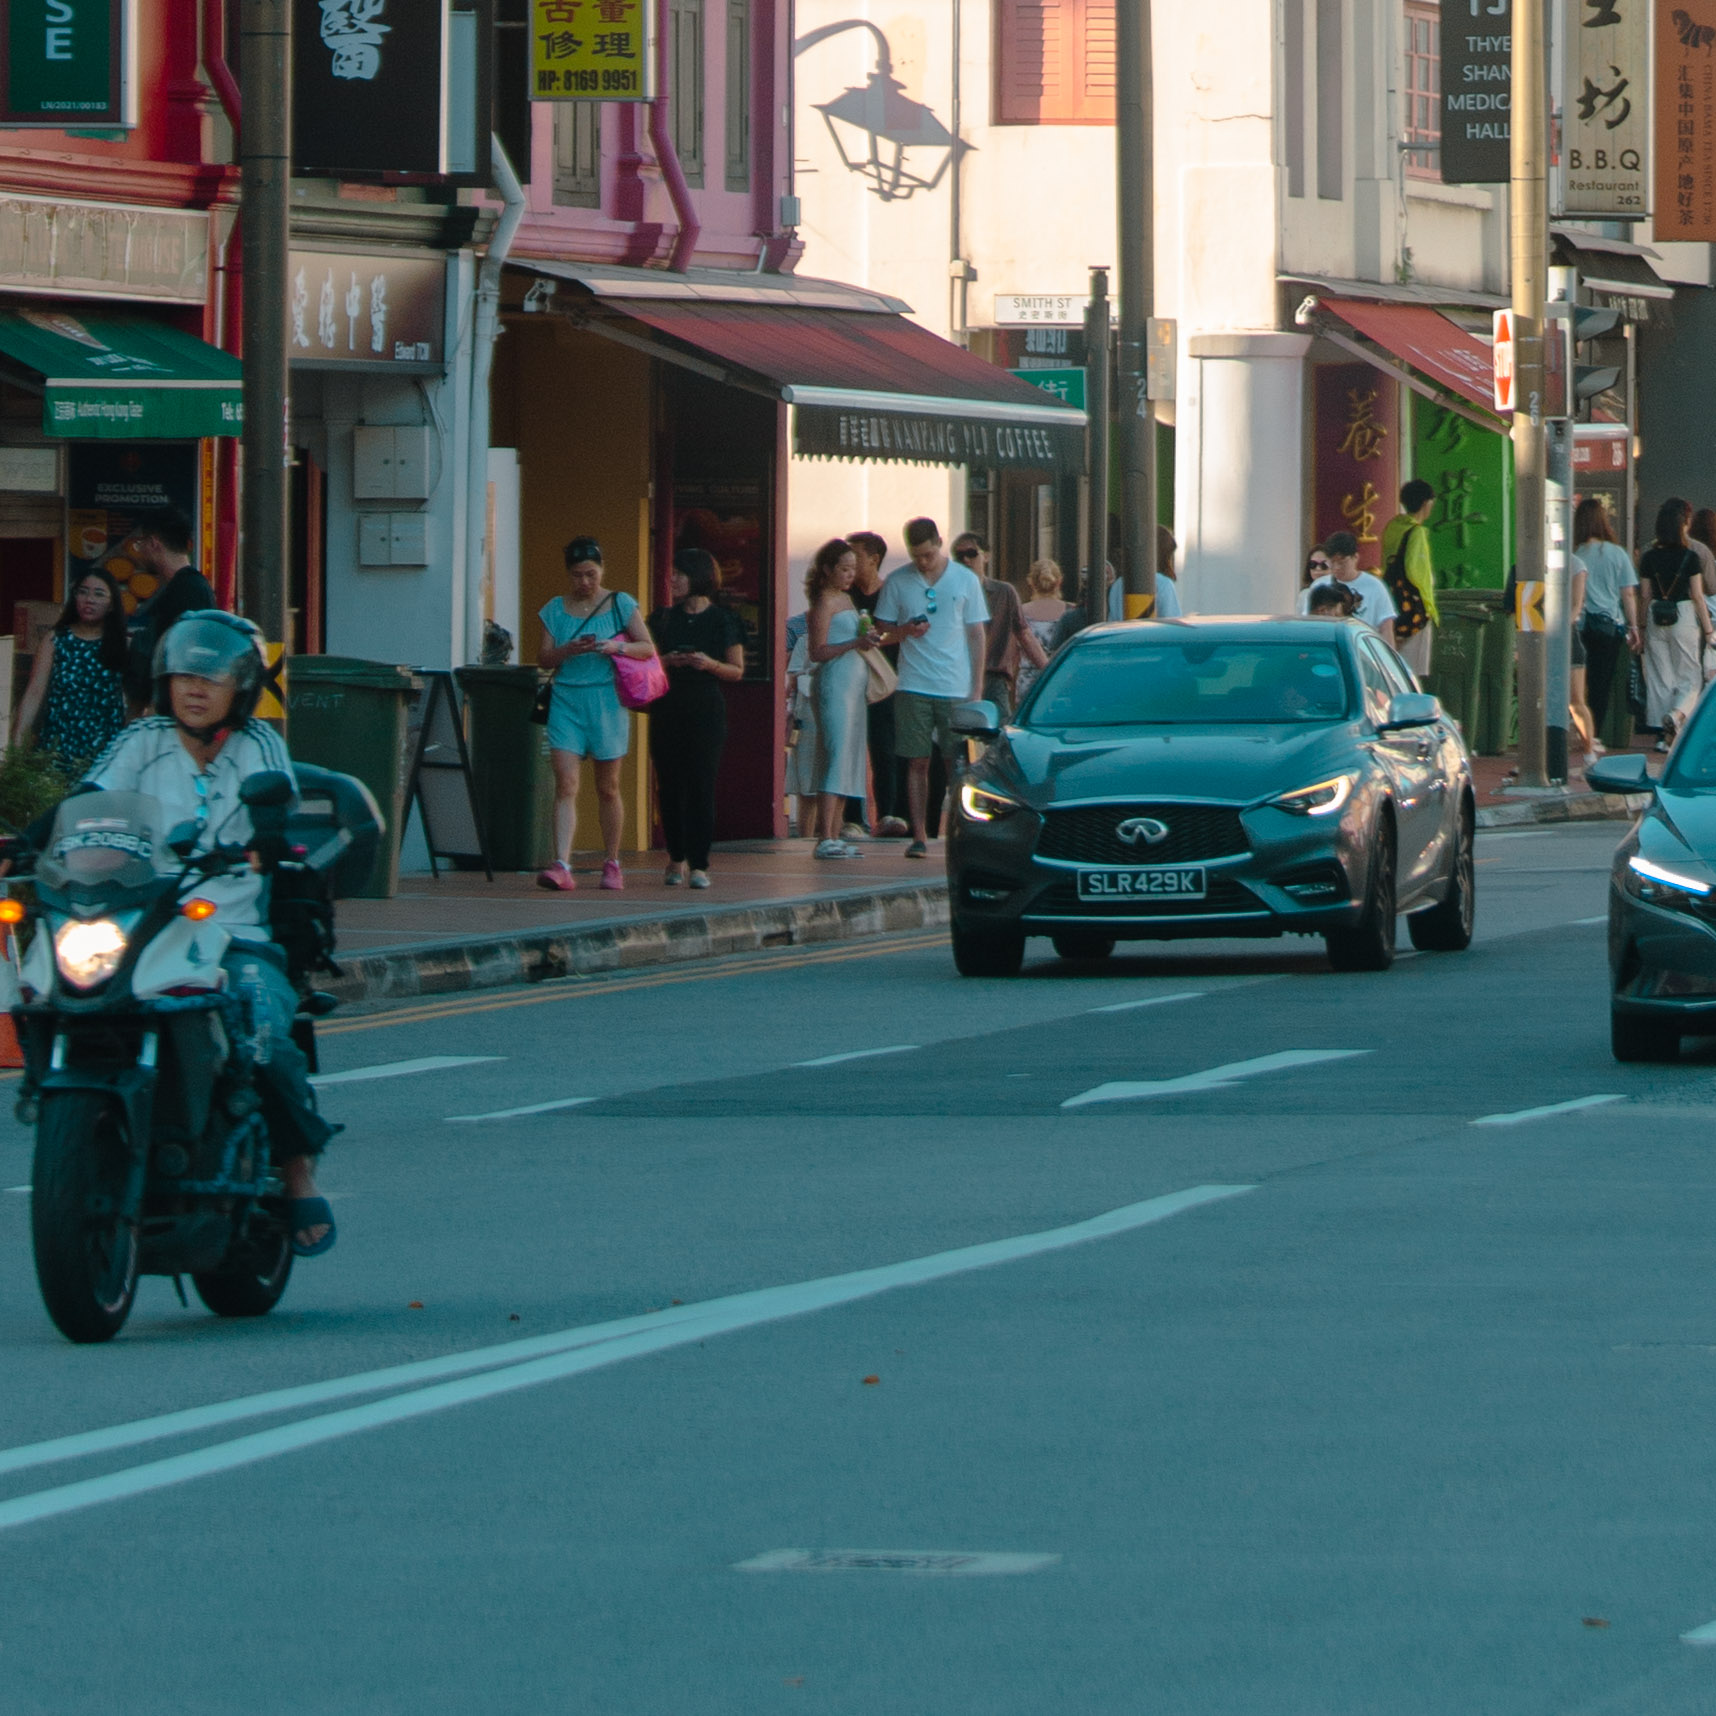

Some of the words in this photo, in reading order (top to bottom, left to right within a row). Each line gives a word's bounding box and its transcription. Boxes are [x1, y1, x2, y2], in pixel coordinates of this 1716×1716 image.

[538, 30, 636, 59] 修理
[1466, 36, 1511, 52] THYE
[538, 70, 560, 91] HP:
[563, 70, 598, 91] 8169
[602, 70, 637, 91] 9951
[1466, 124, 1511, 139] HALL
[1569, 149, 1641, 172] B.B.Q
[1569, 179, 1639, 192] Restaurant
[1617, 195, 1641, 206] 262
[1013, 297, 1053, 309] SMITH
[1057, 297, 1072, 309] ST
[1136, 378, 1148, 419] 24
[996, 427, 1054, 459] COFFEE
[95, 494, 168, 504] PROMOTION
[1088, 872, 1195, 893] SLR429K
